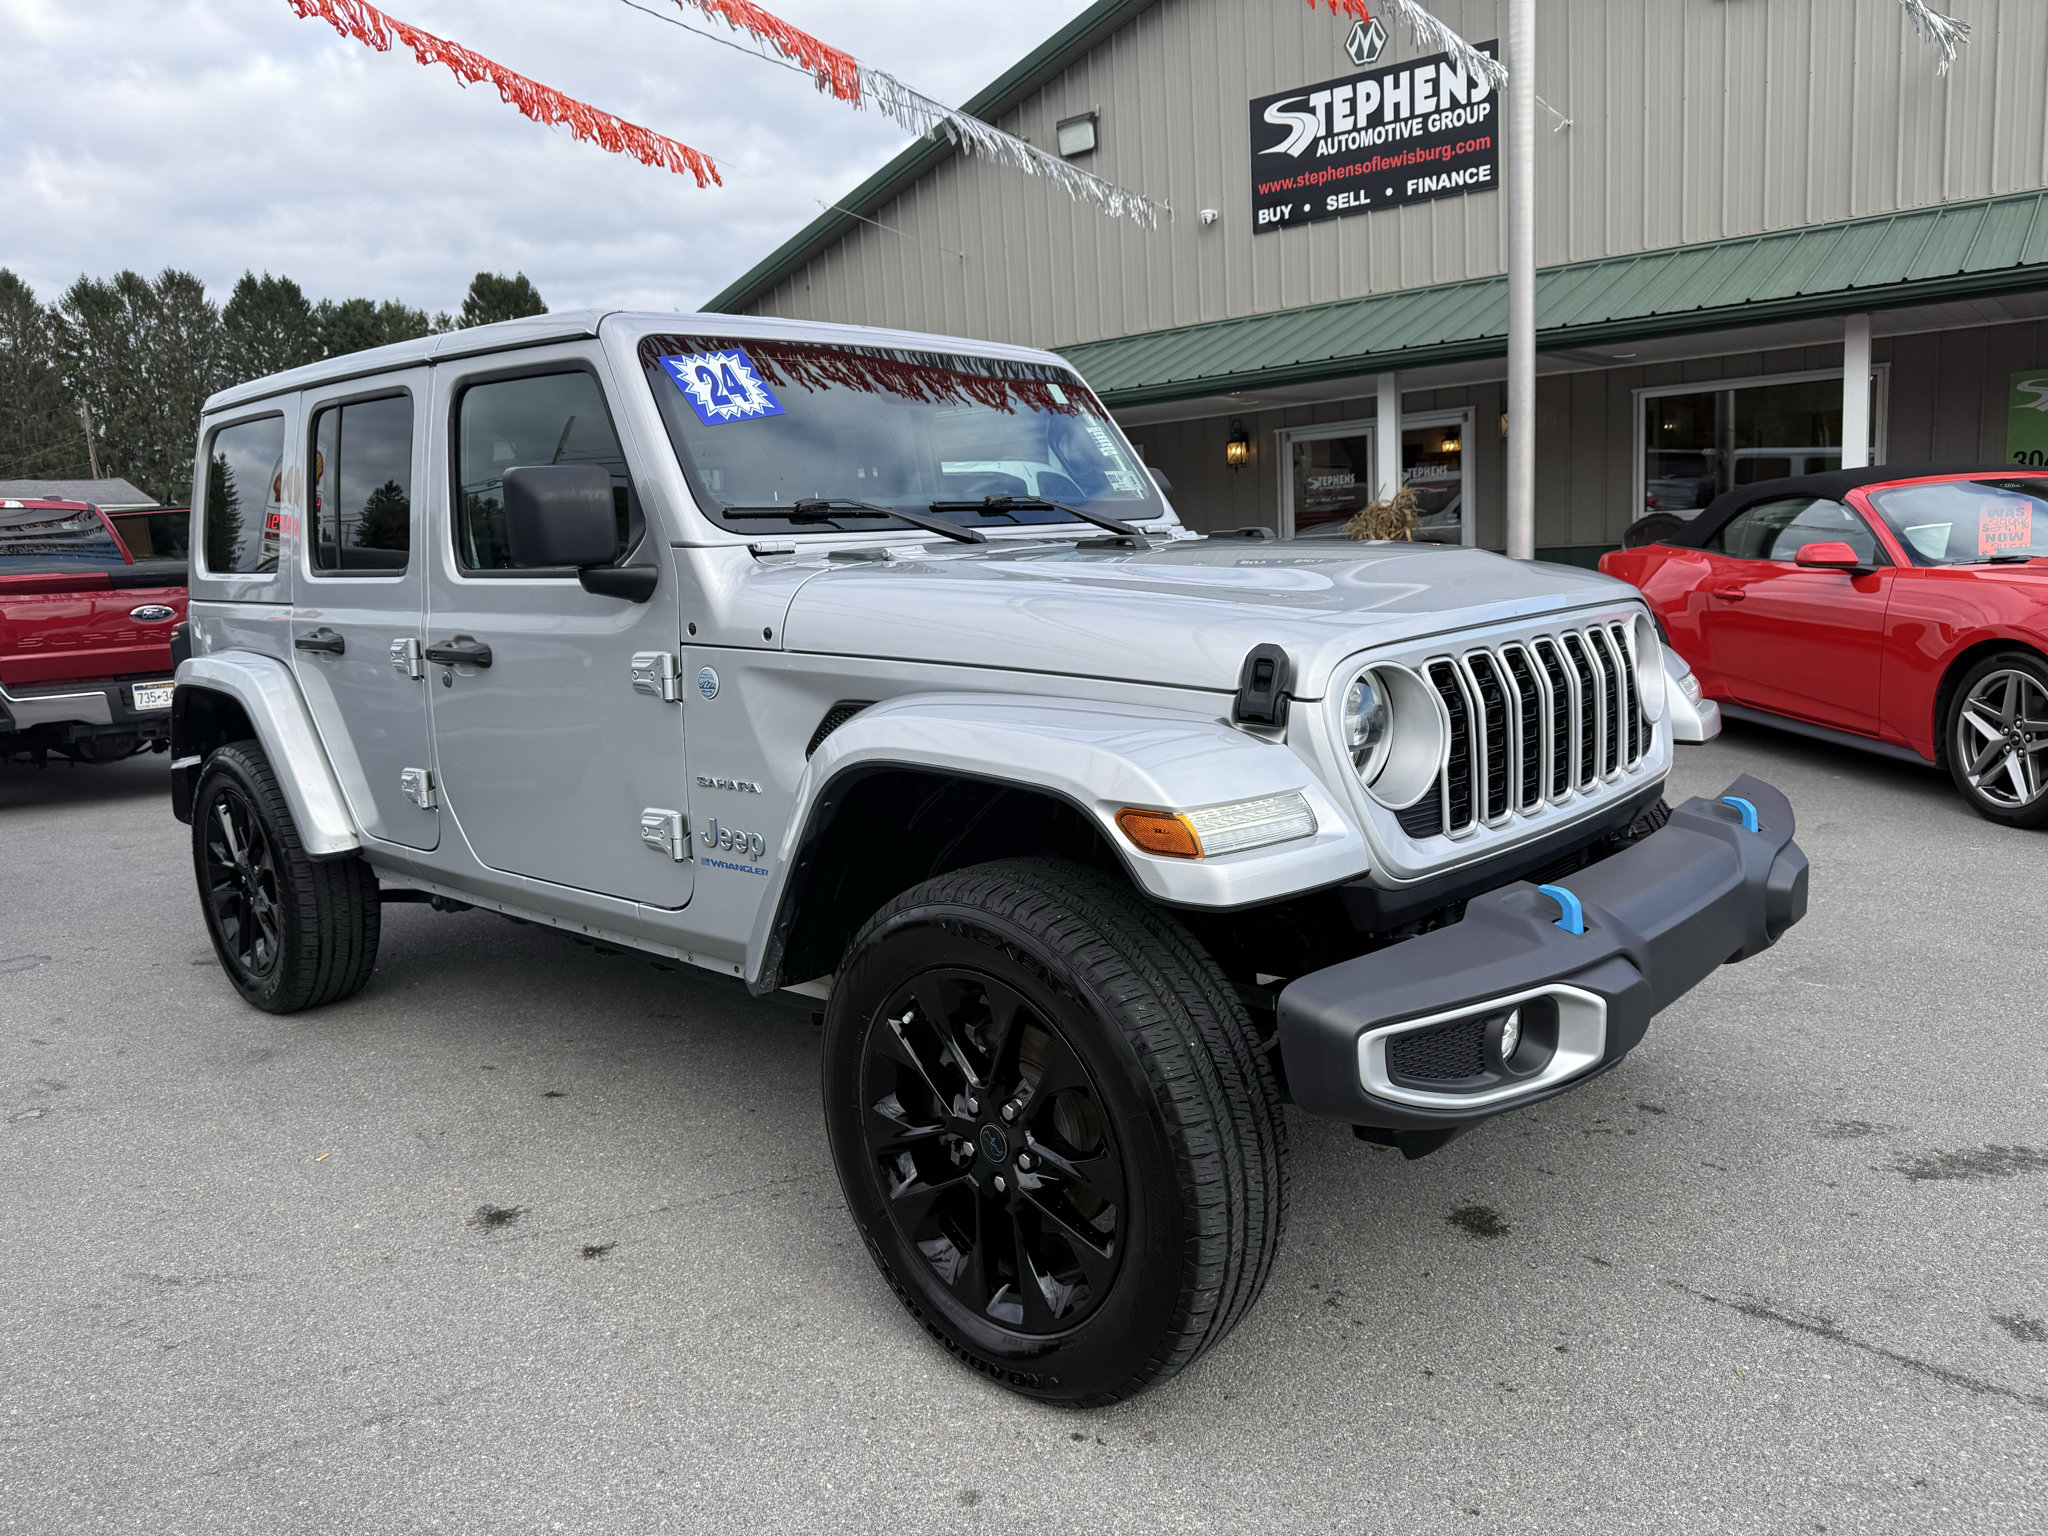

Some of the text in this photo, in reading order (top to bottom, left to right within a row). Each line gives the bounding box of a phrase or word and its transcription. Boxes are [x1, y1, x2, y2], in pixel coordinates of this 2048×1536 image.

[1257, 50, 1491, 158] STEPHENS
[1316, 102, 1491, 158] AUTOMOTIVE GROUP
[1258, 136, 1491, 195] www.stephensoflewisburg.com
[1258, 164, 1492, 225] BUY SELL FINANCE
[694, 362, 752, 408] 24
[2012, 449, 2048, 466] 30
[1307, 472, 1356, 490] STEPHENS
[1987, 507, 2025, 518] WAS
[1985, 532, 2025, 543] NOW
[696, 775, 763, 794] SAHARA
[700, 817, 766, 862] Jeep
[710, 859, 769, 876] WRANGLER
